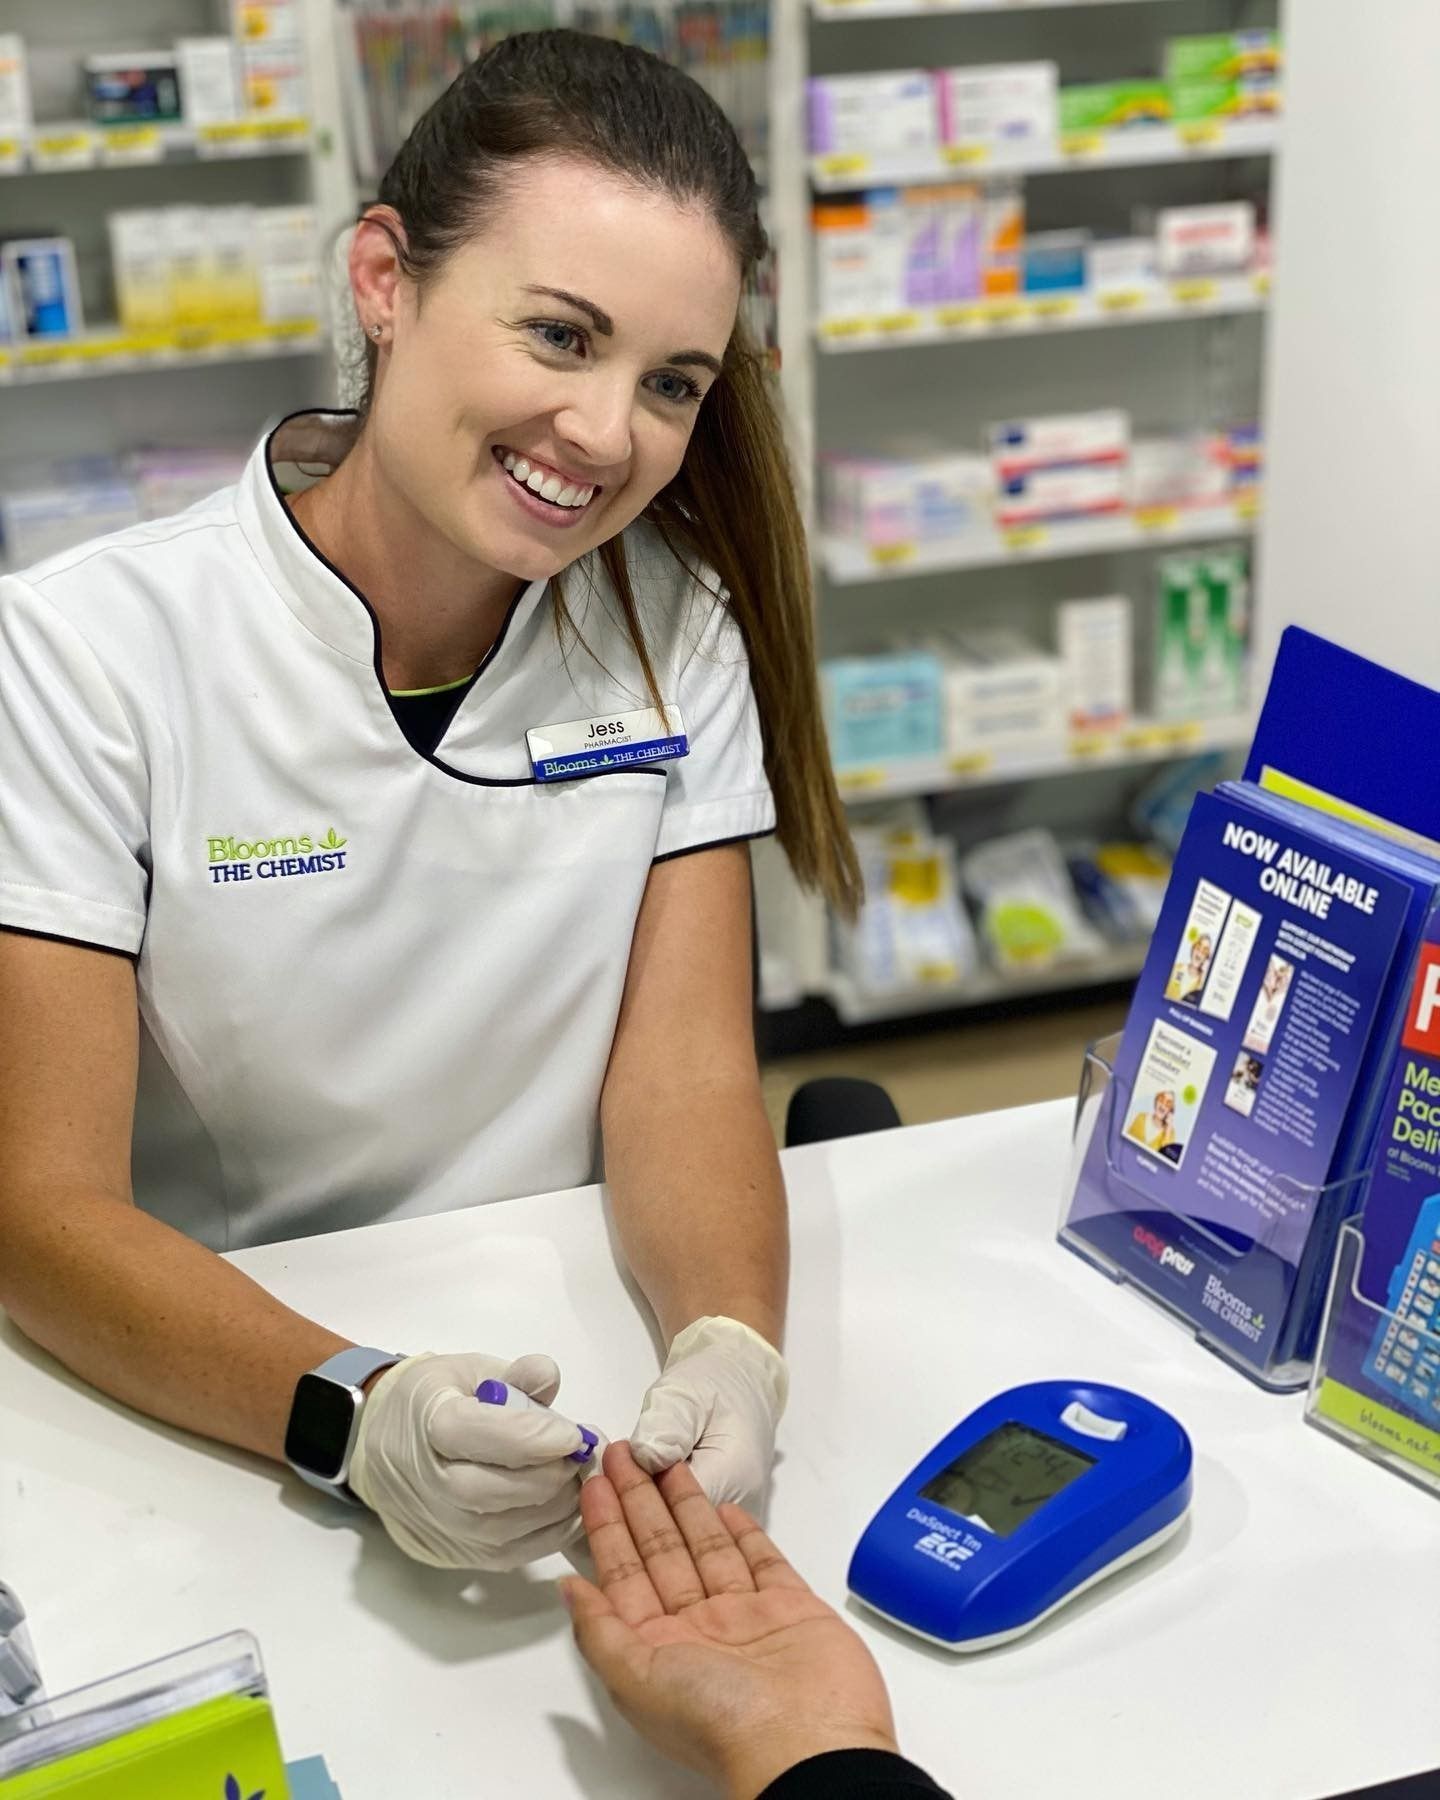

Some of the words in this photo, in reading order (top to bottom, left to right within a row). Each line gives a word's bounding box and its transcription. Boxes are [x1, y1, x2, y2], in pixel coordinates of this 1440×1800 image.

[584, 735, 632, 750] PHARMACIST
[587, 720, 625, 738] Jess
[543, 757, 597, 777] Blooms
[613, 750, 634, 764] THE
[637, 743, 681, 760] CHEMIST
[207, 835, 314, 863] Blooms
[208, 863, 253, 883] THE
[256, 851, 347, 879] CHEMIST
[1222, 821, 1280, 864] NOW
[1275, 847, 1379, 915] AVAILABLE
[1259, 866, 1332, 920] ONLINE
[1392, 1115, 1440, 1155] Deli
[1204, 1273, 1253, 1321] Blooms
[1201, 1292, 1221, 1315] THE
[1219, 1307, 1262, 1343] CHEMIST
[906, 1507, 962, 1540] DiaSpect
[917, 1531, 975, 1562] EKF
